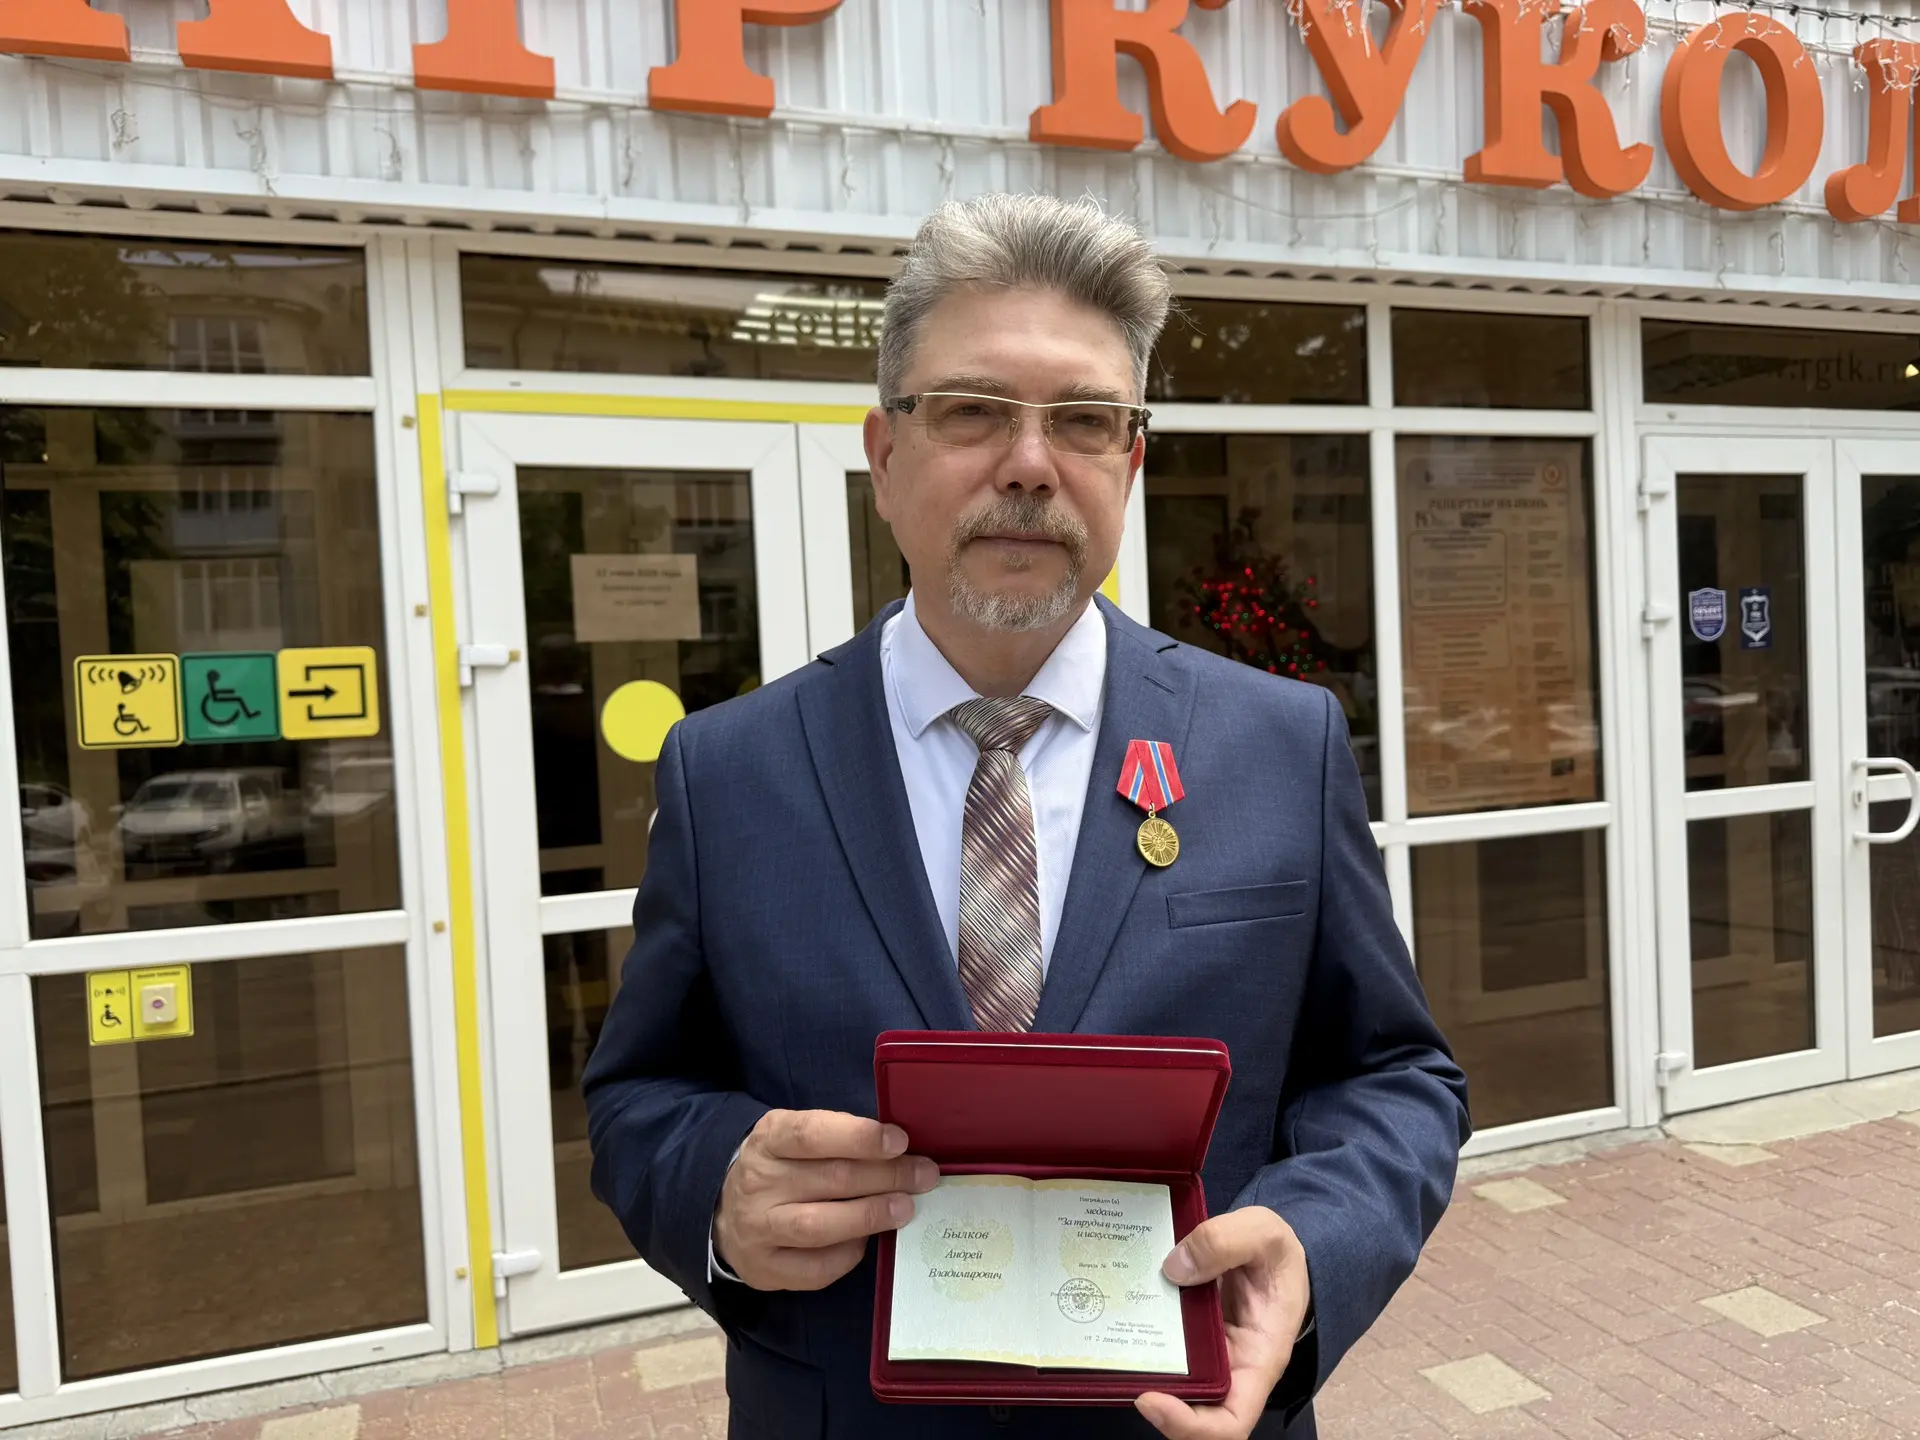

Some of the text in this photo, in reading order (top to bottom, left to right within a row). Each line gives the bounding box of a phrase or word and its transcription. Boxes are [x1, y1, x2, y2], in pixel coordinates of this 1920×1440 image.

[1084, 1207, 1123, 1217] медалью
[1074, 1219, 1104, 1228] труды
[1112, 1223, 1152, 1233] культуре
[942, 1228, 990, 1239] Былков
[945, 1249, 983, 1261] Андрей
[928, 1268, 1002, 1280] Владимирович
